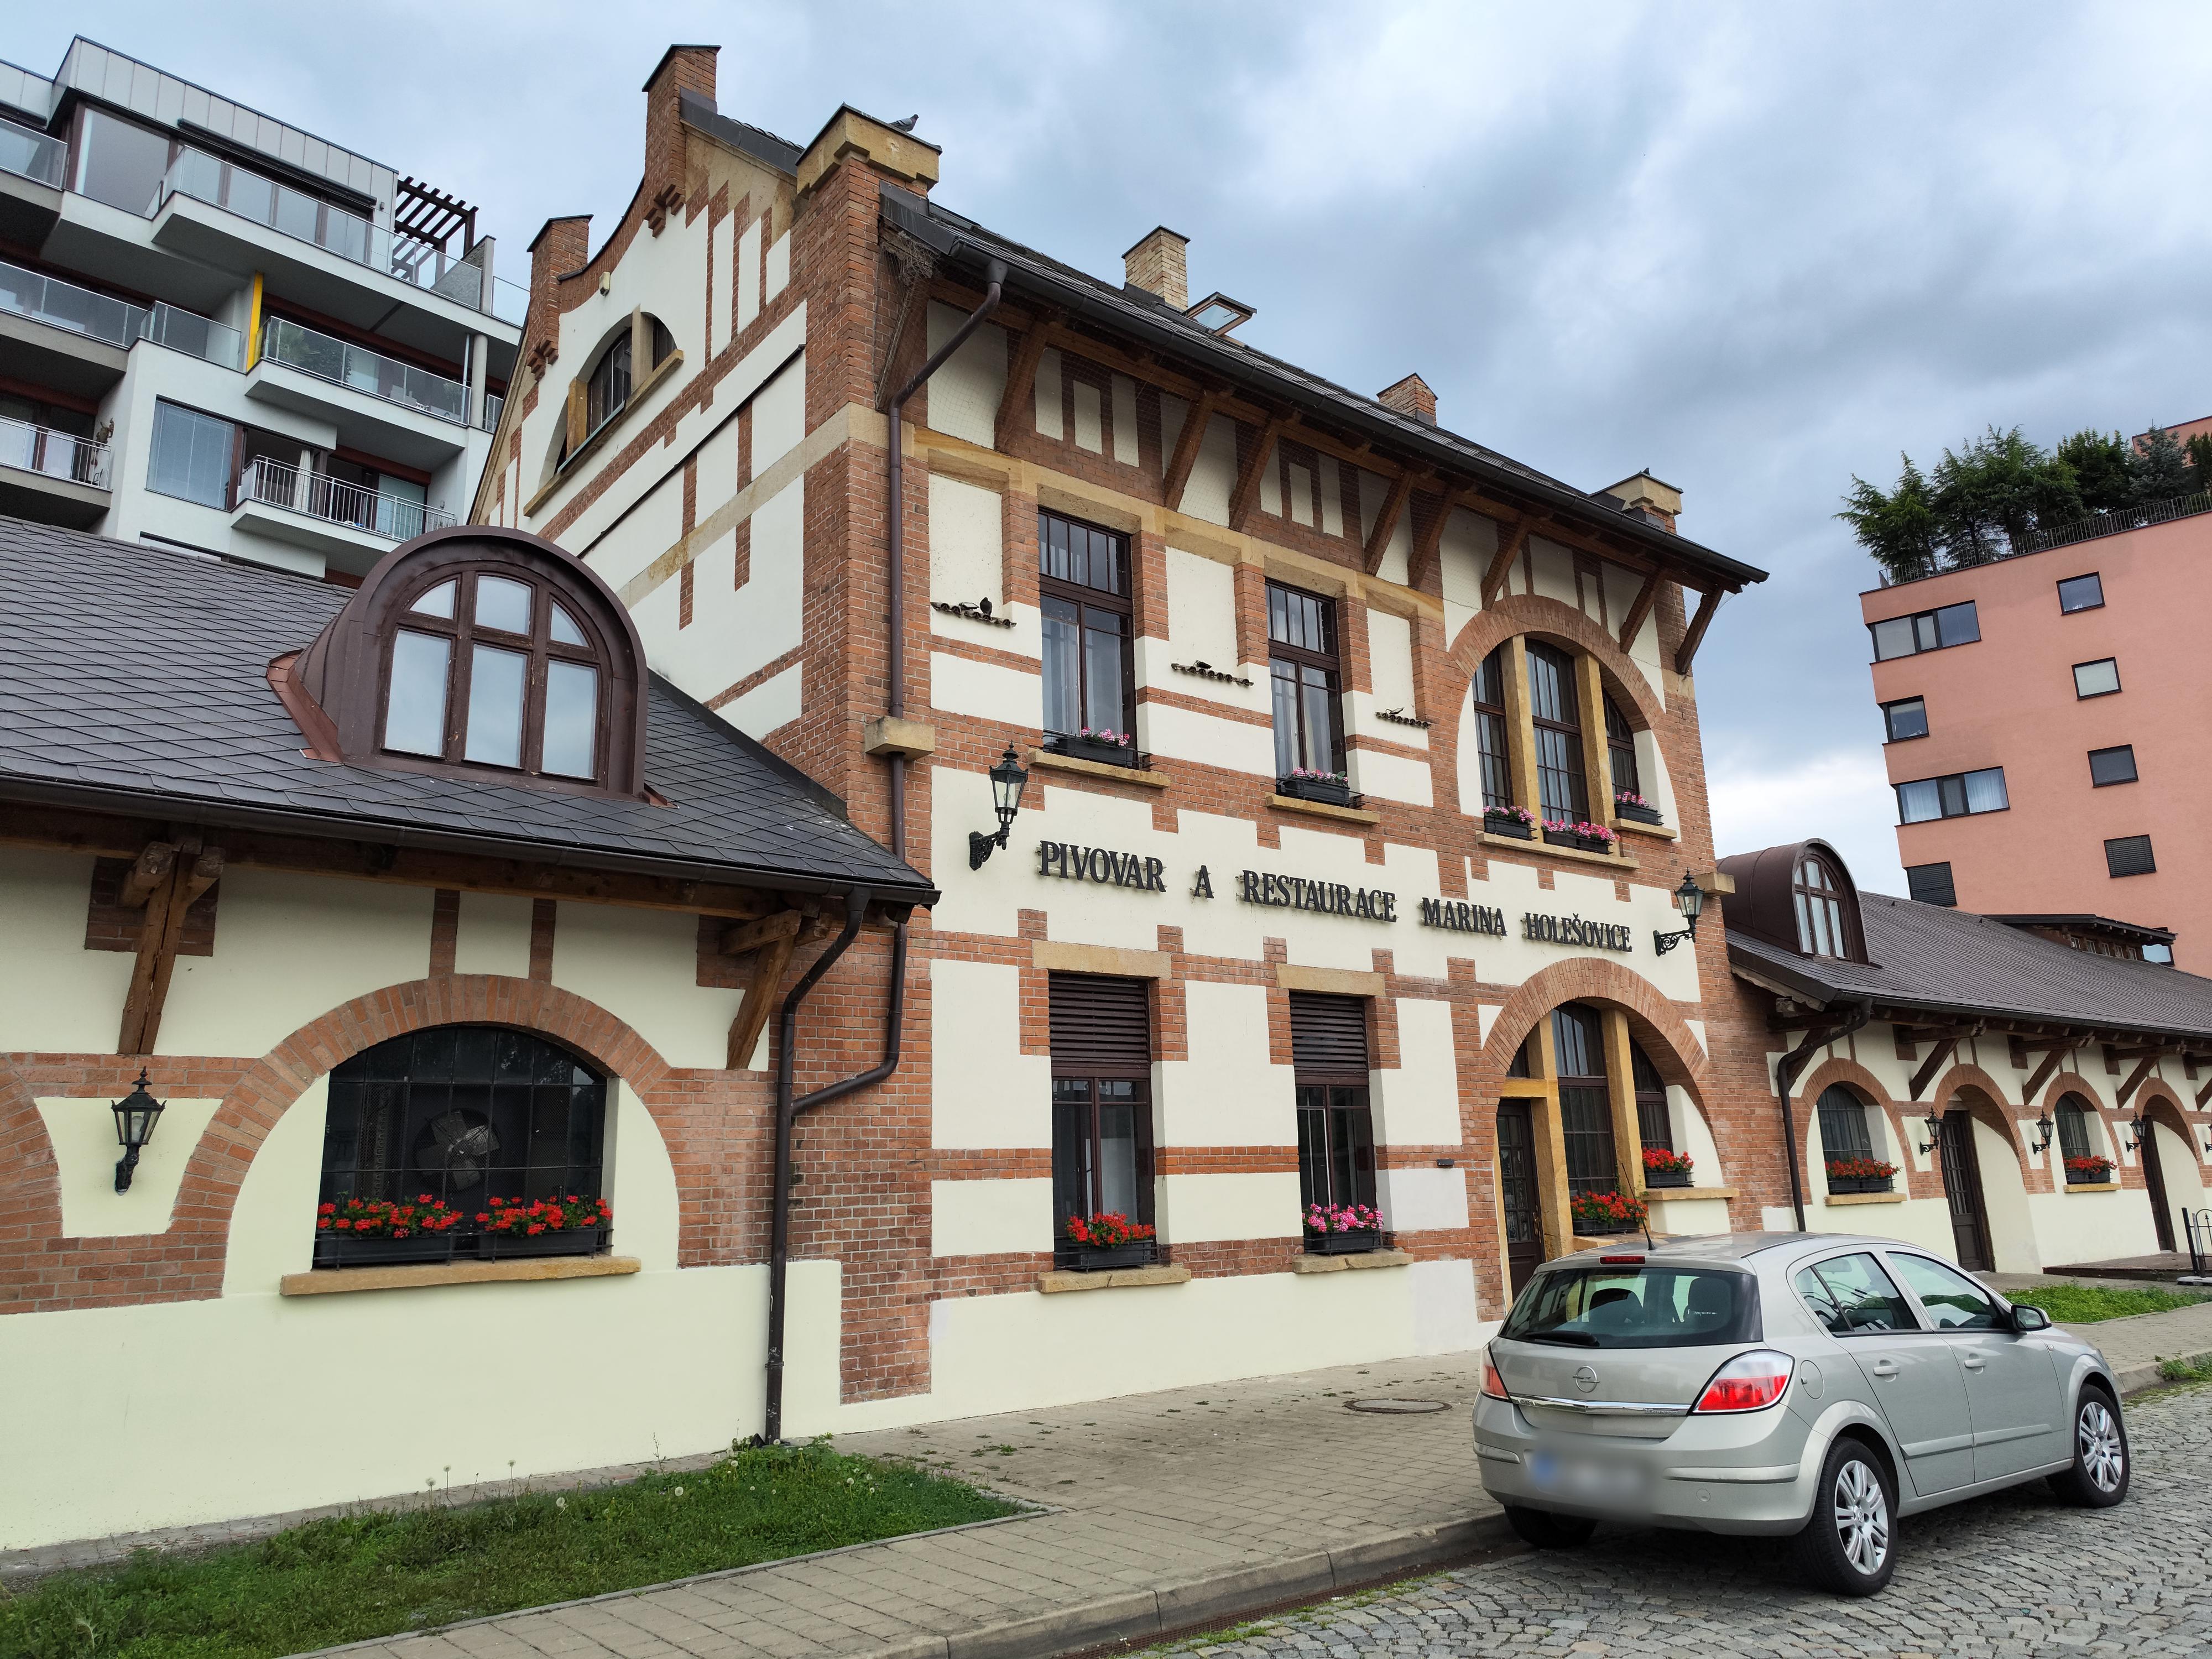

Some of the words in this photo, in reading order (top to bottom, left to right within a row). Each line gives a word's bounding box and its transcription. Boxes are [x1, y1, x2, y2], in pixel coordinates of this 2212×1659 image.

[1040, 840, 1167, 893] PIVOVAR
[1193, 864, 1215, 899] A
[1242, 869, 1397, 923] RESTAURACE
[1422, 897, 1508, 937] MARINA
[1525, 912, 1632, 952] HOLEŠOVICE
